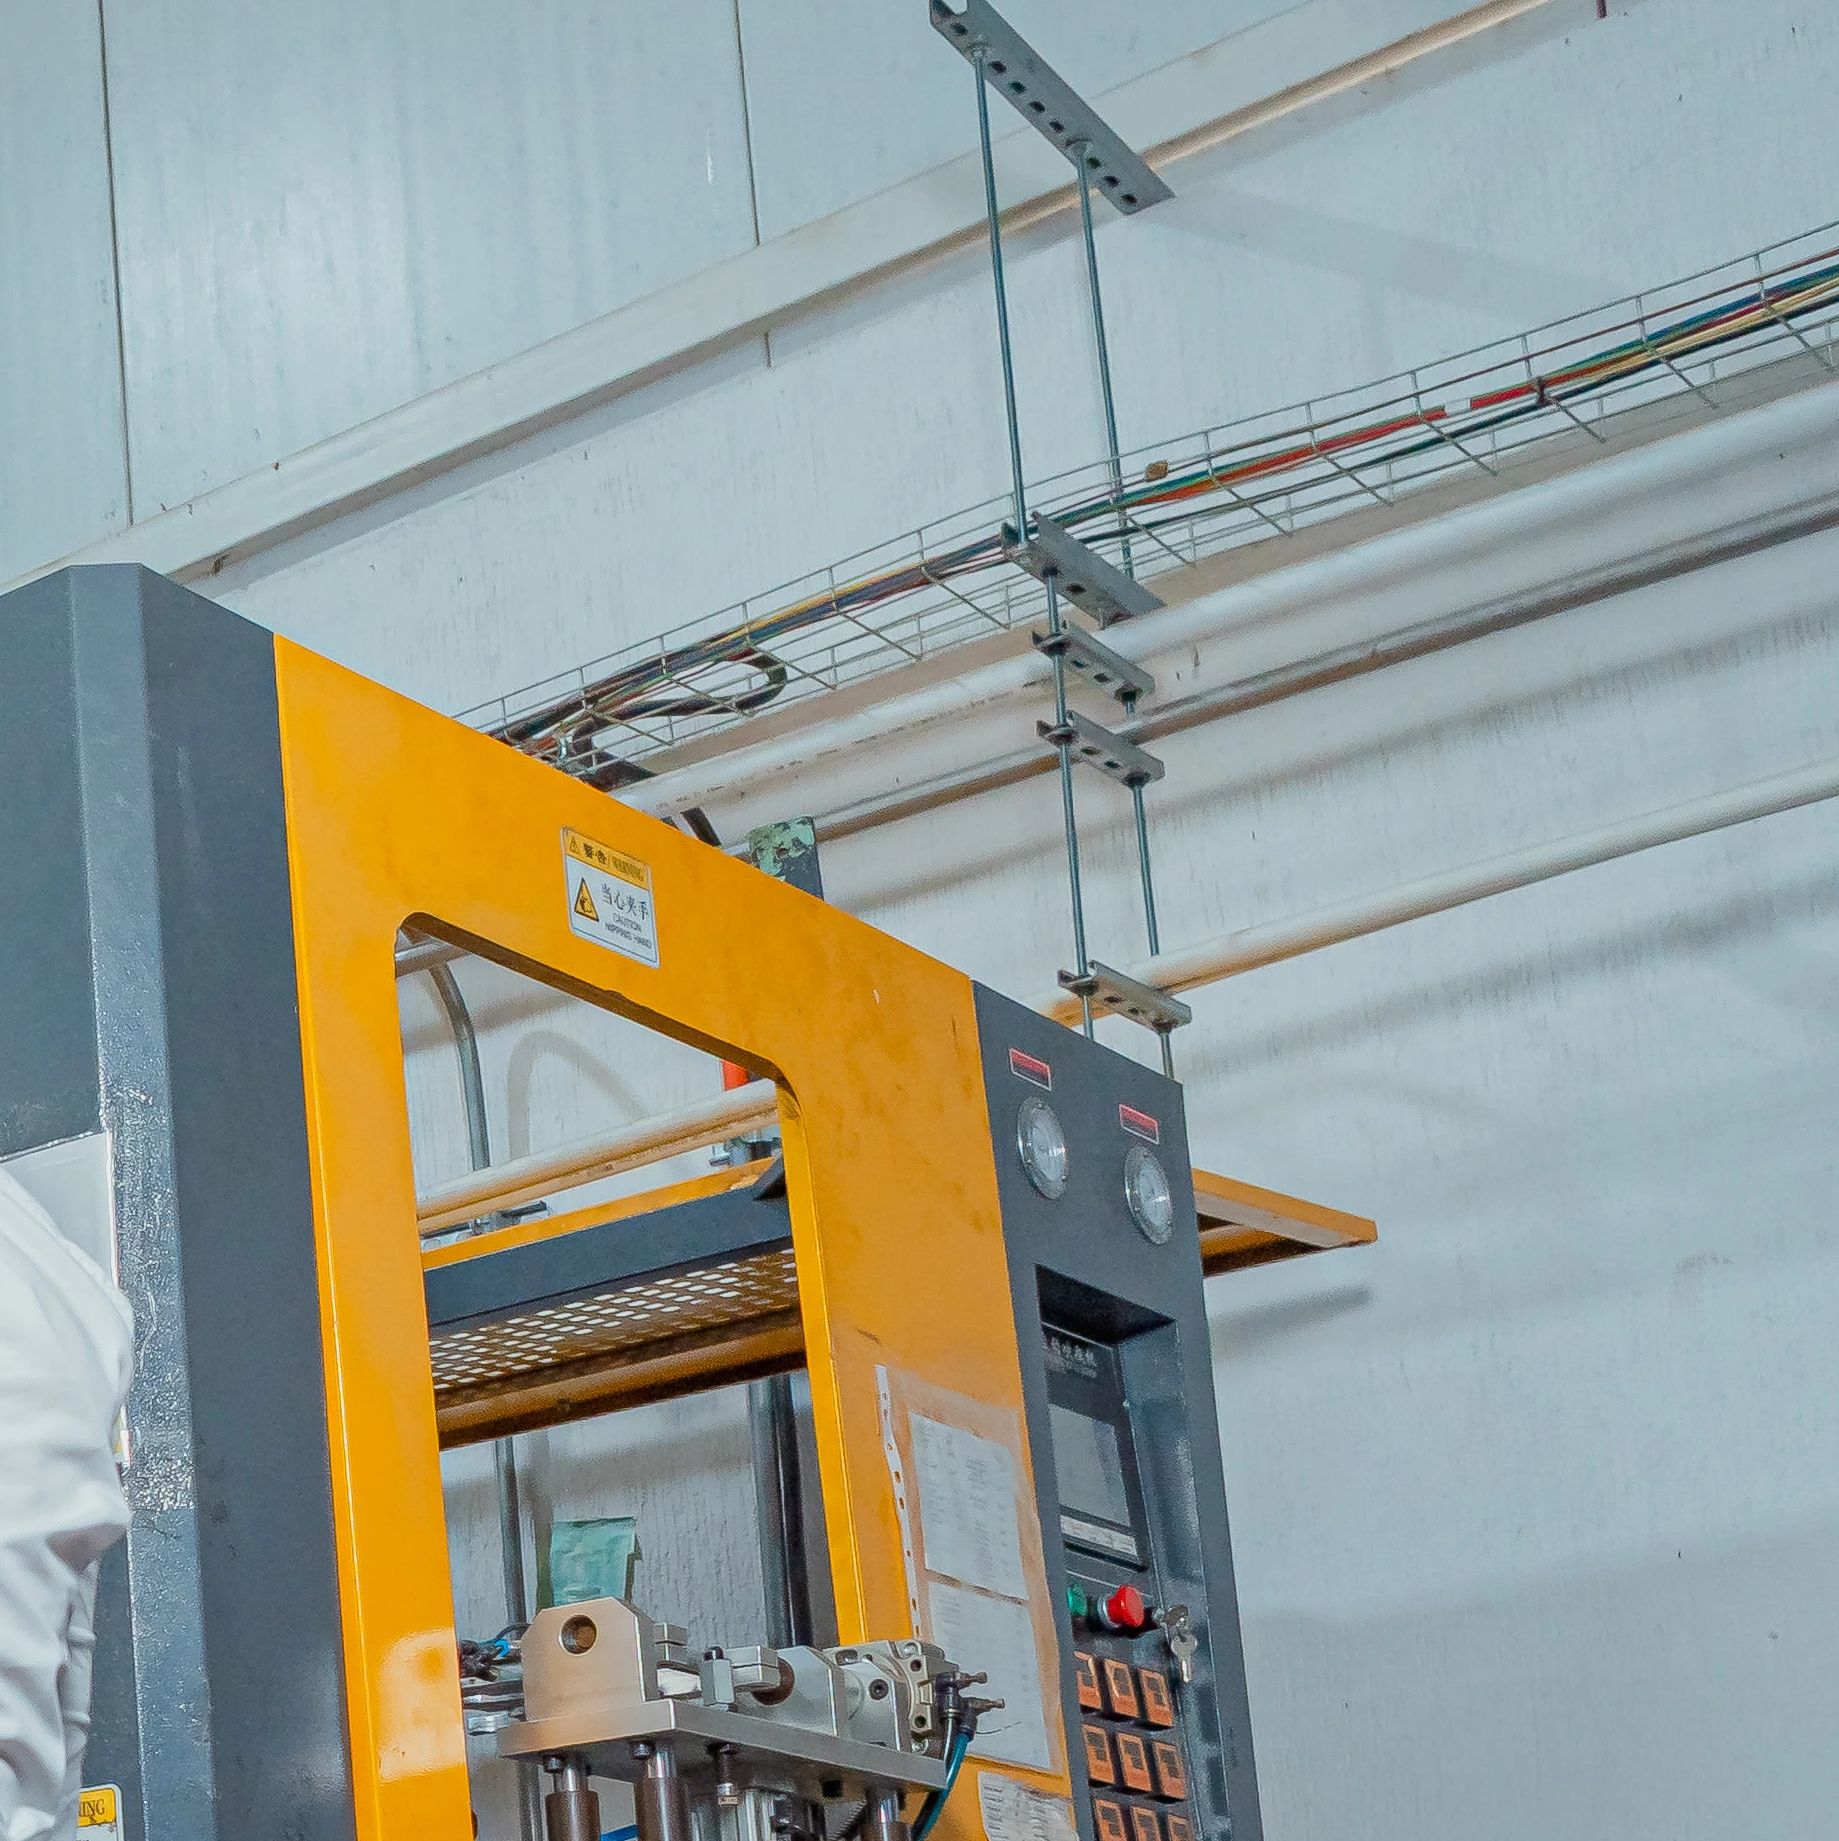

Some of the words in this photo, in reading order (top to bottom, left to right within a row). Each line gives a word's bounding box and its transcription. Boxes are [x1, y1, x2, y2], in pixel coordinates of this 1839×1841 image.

[600, 882, 649, 921] 当心夹手
[612, 912, 642, 933] CAUTION
